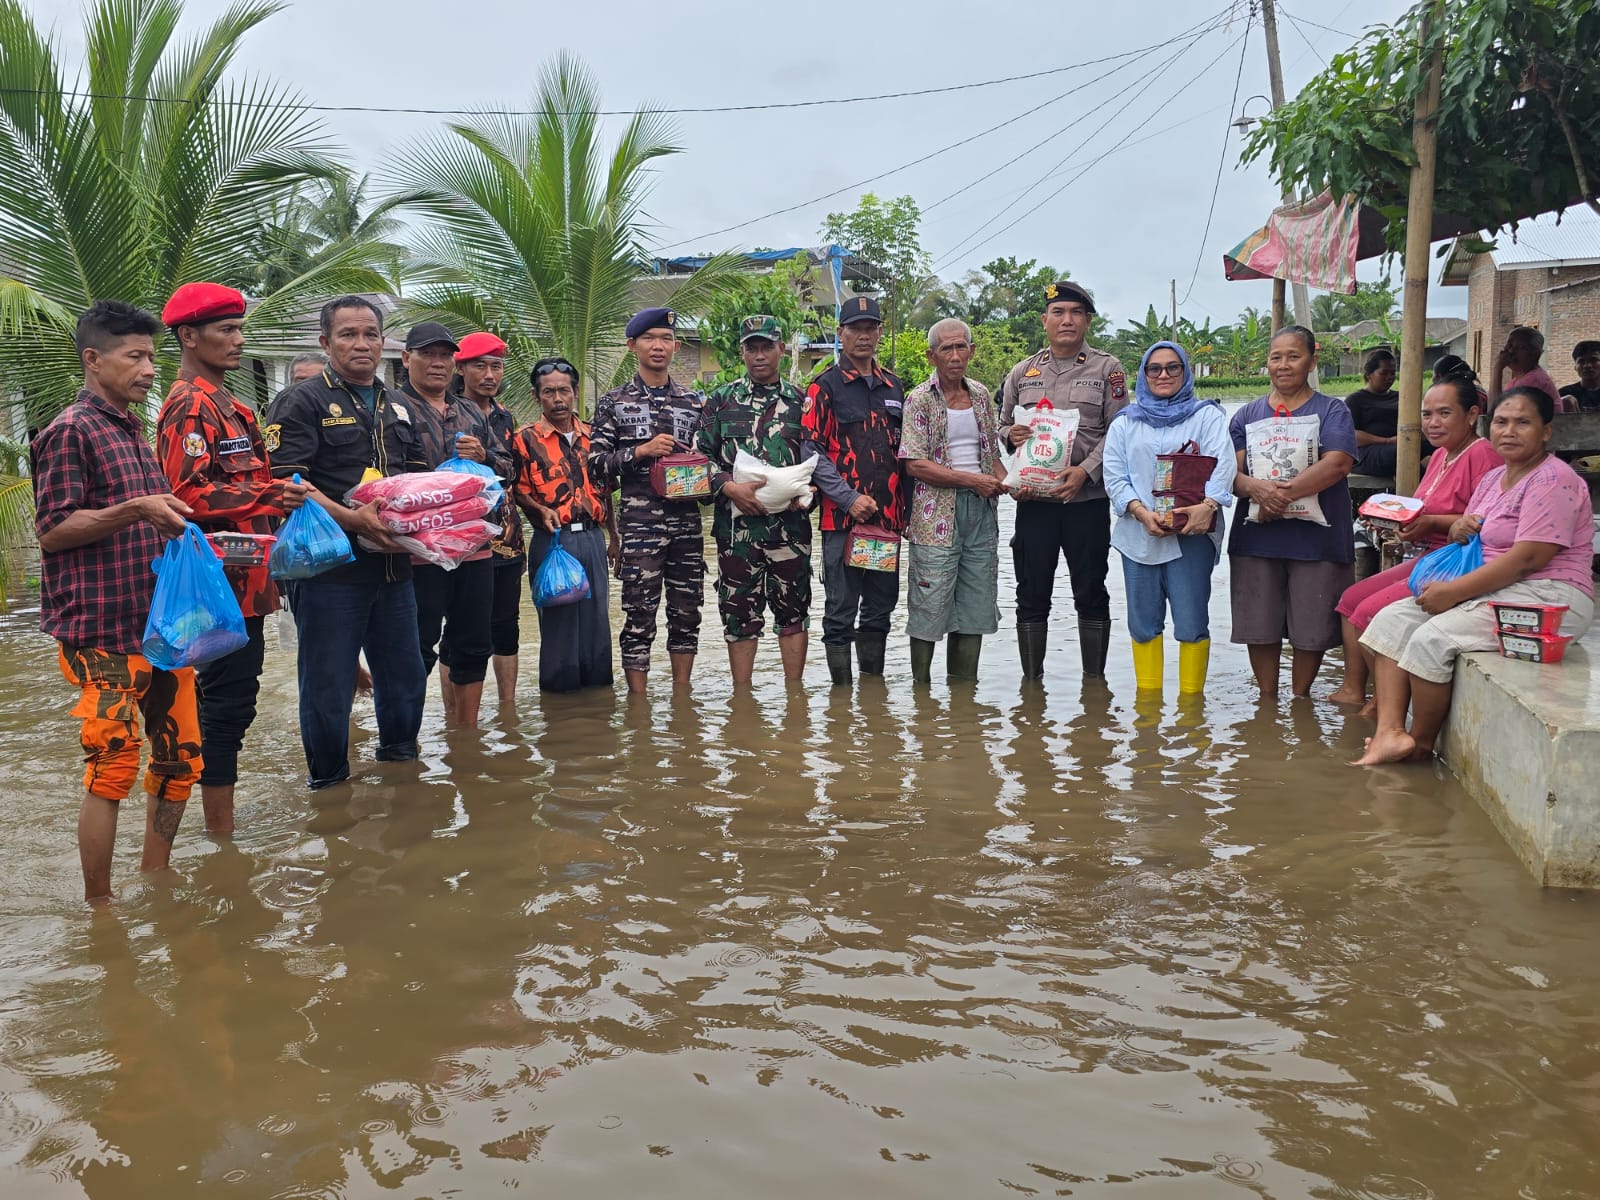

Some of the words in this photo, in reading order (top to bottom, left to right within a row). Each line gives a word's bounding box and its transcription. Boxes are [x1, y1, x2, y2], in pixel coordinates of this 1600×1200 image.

[1075, 380, 1102, 388] POLRI
[620, 416, 647, 425] AKBAR
[675, 418, 689, 427] TNI
